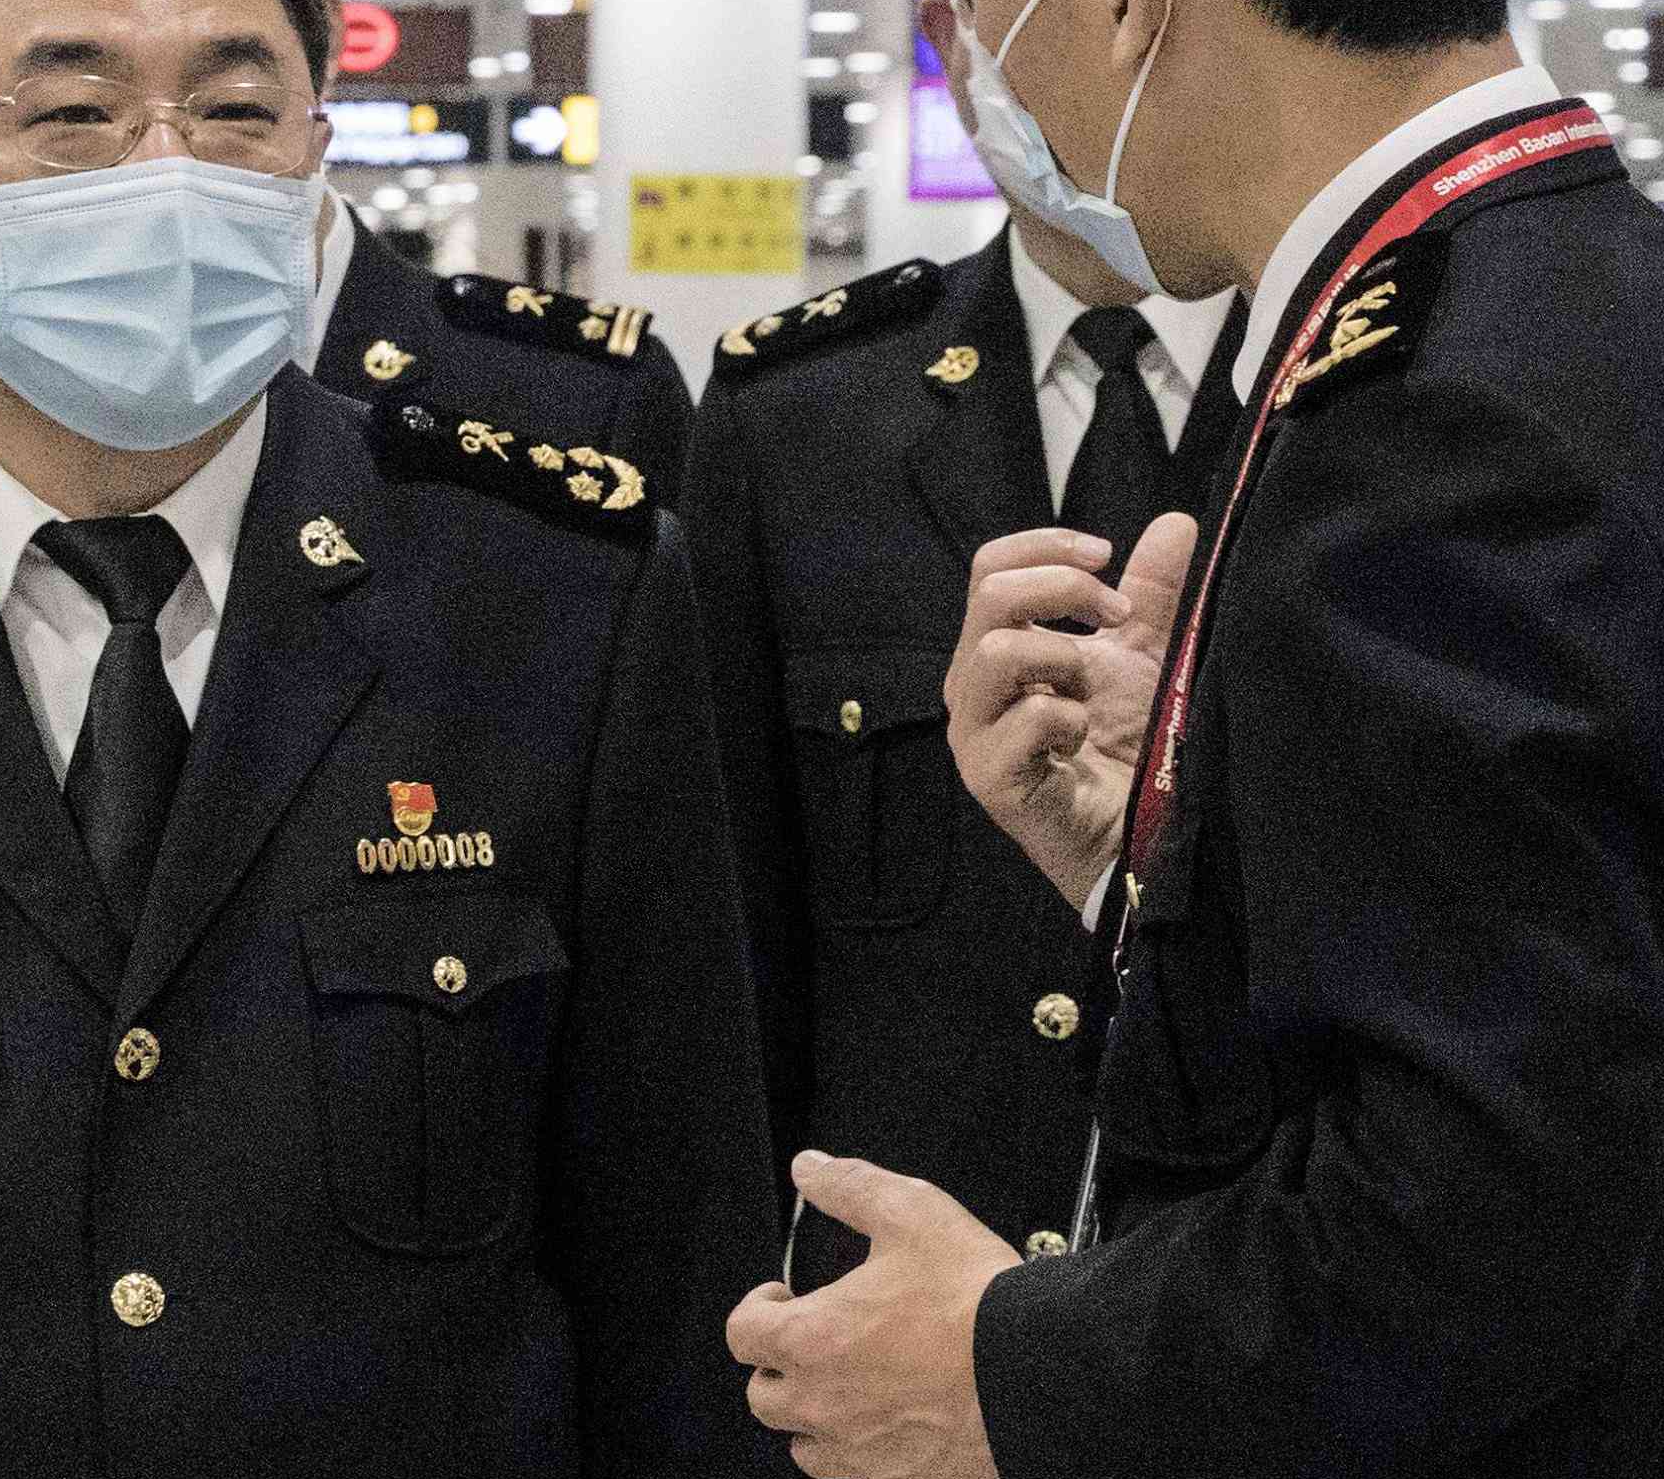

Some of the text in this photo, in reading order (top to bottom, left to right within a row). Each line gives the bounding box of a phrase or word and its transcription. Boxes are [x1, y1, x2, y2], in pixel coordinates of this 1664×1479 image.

[1432, 146, 1521, 196] Shenzhen
[1519, 130, 1567, 154] Baoan
[356, 831, 494, 873] 0000008
